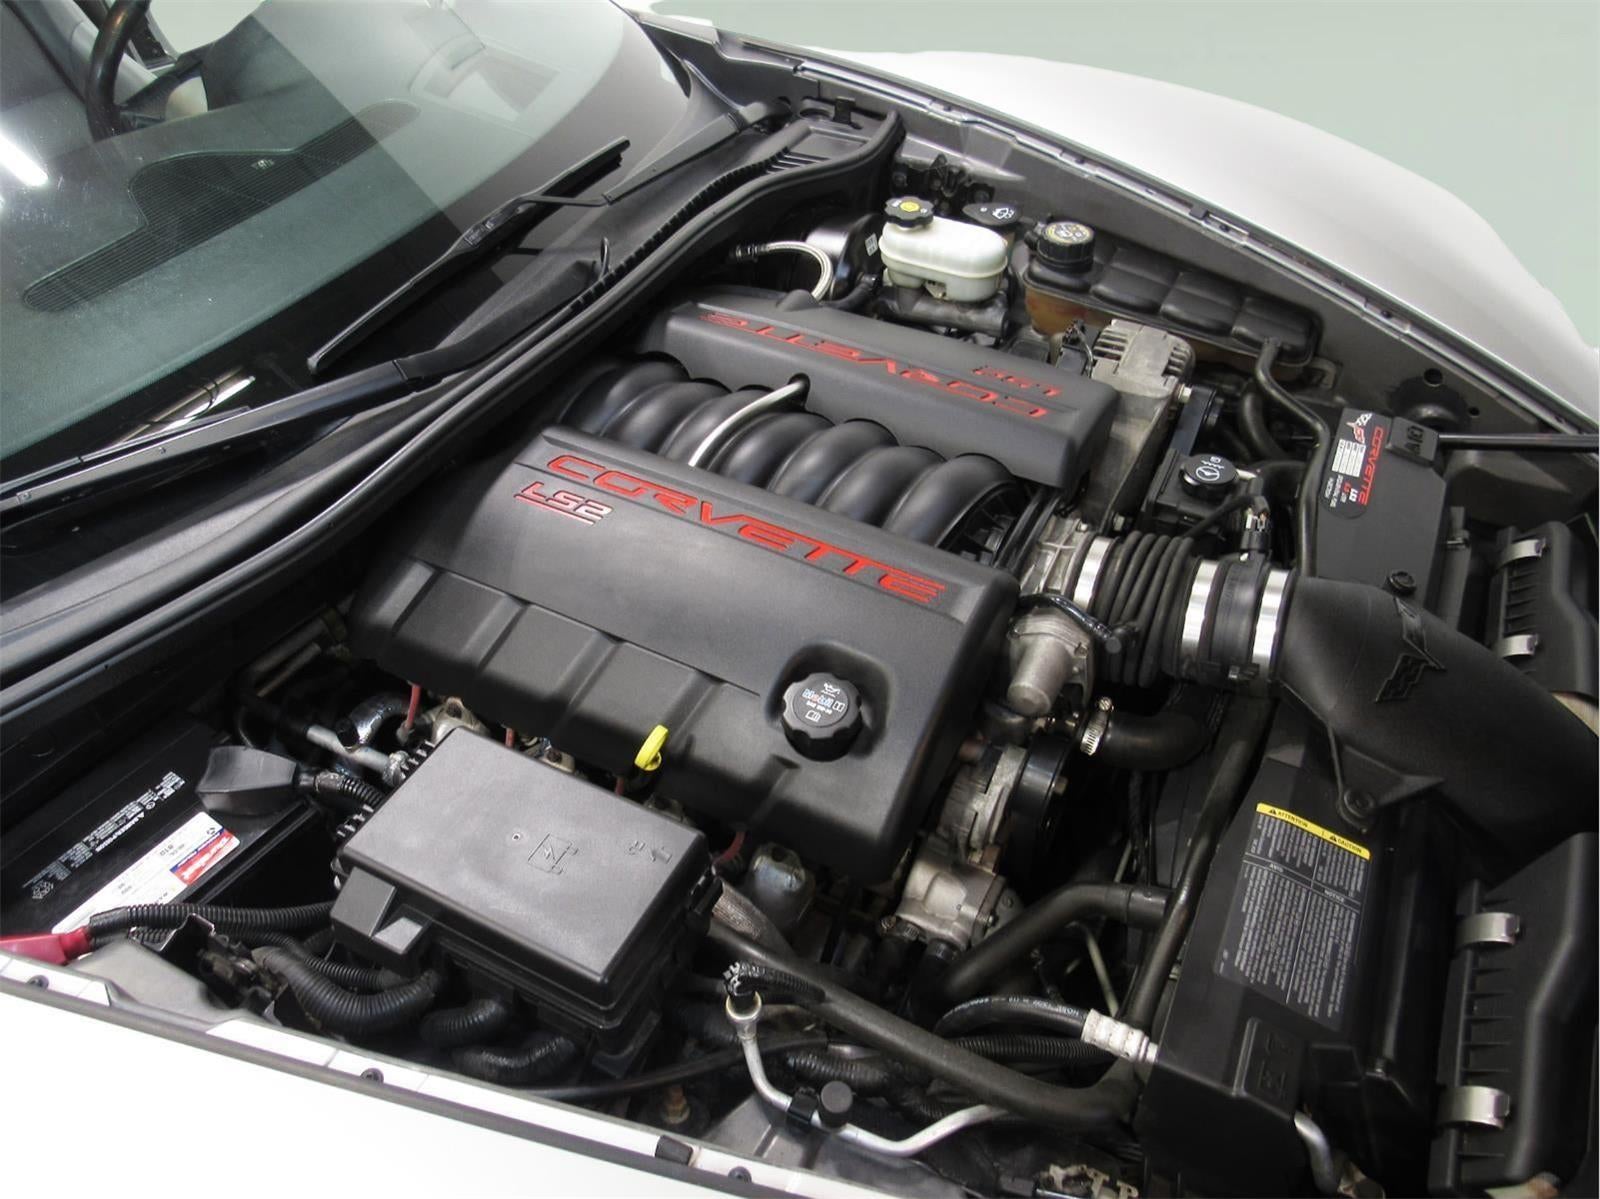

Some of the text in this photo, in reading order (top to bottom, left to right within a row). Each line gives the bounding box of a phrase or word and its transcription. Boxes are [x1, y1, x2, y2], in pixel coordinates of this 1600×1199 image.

[699, 313, 1048, 419] CORVETTE
[1359, 426, 1384, 505] CORVETTE
[514, 481, 614, 523] LS2
[546, 454, 946, 604] CORVETTE
[1277, 809, 1308, 828] ATTENTION
[1336, 837, 1362, 854] CAUTION
